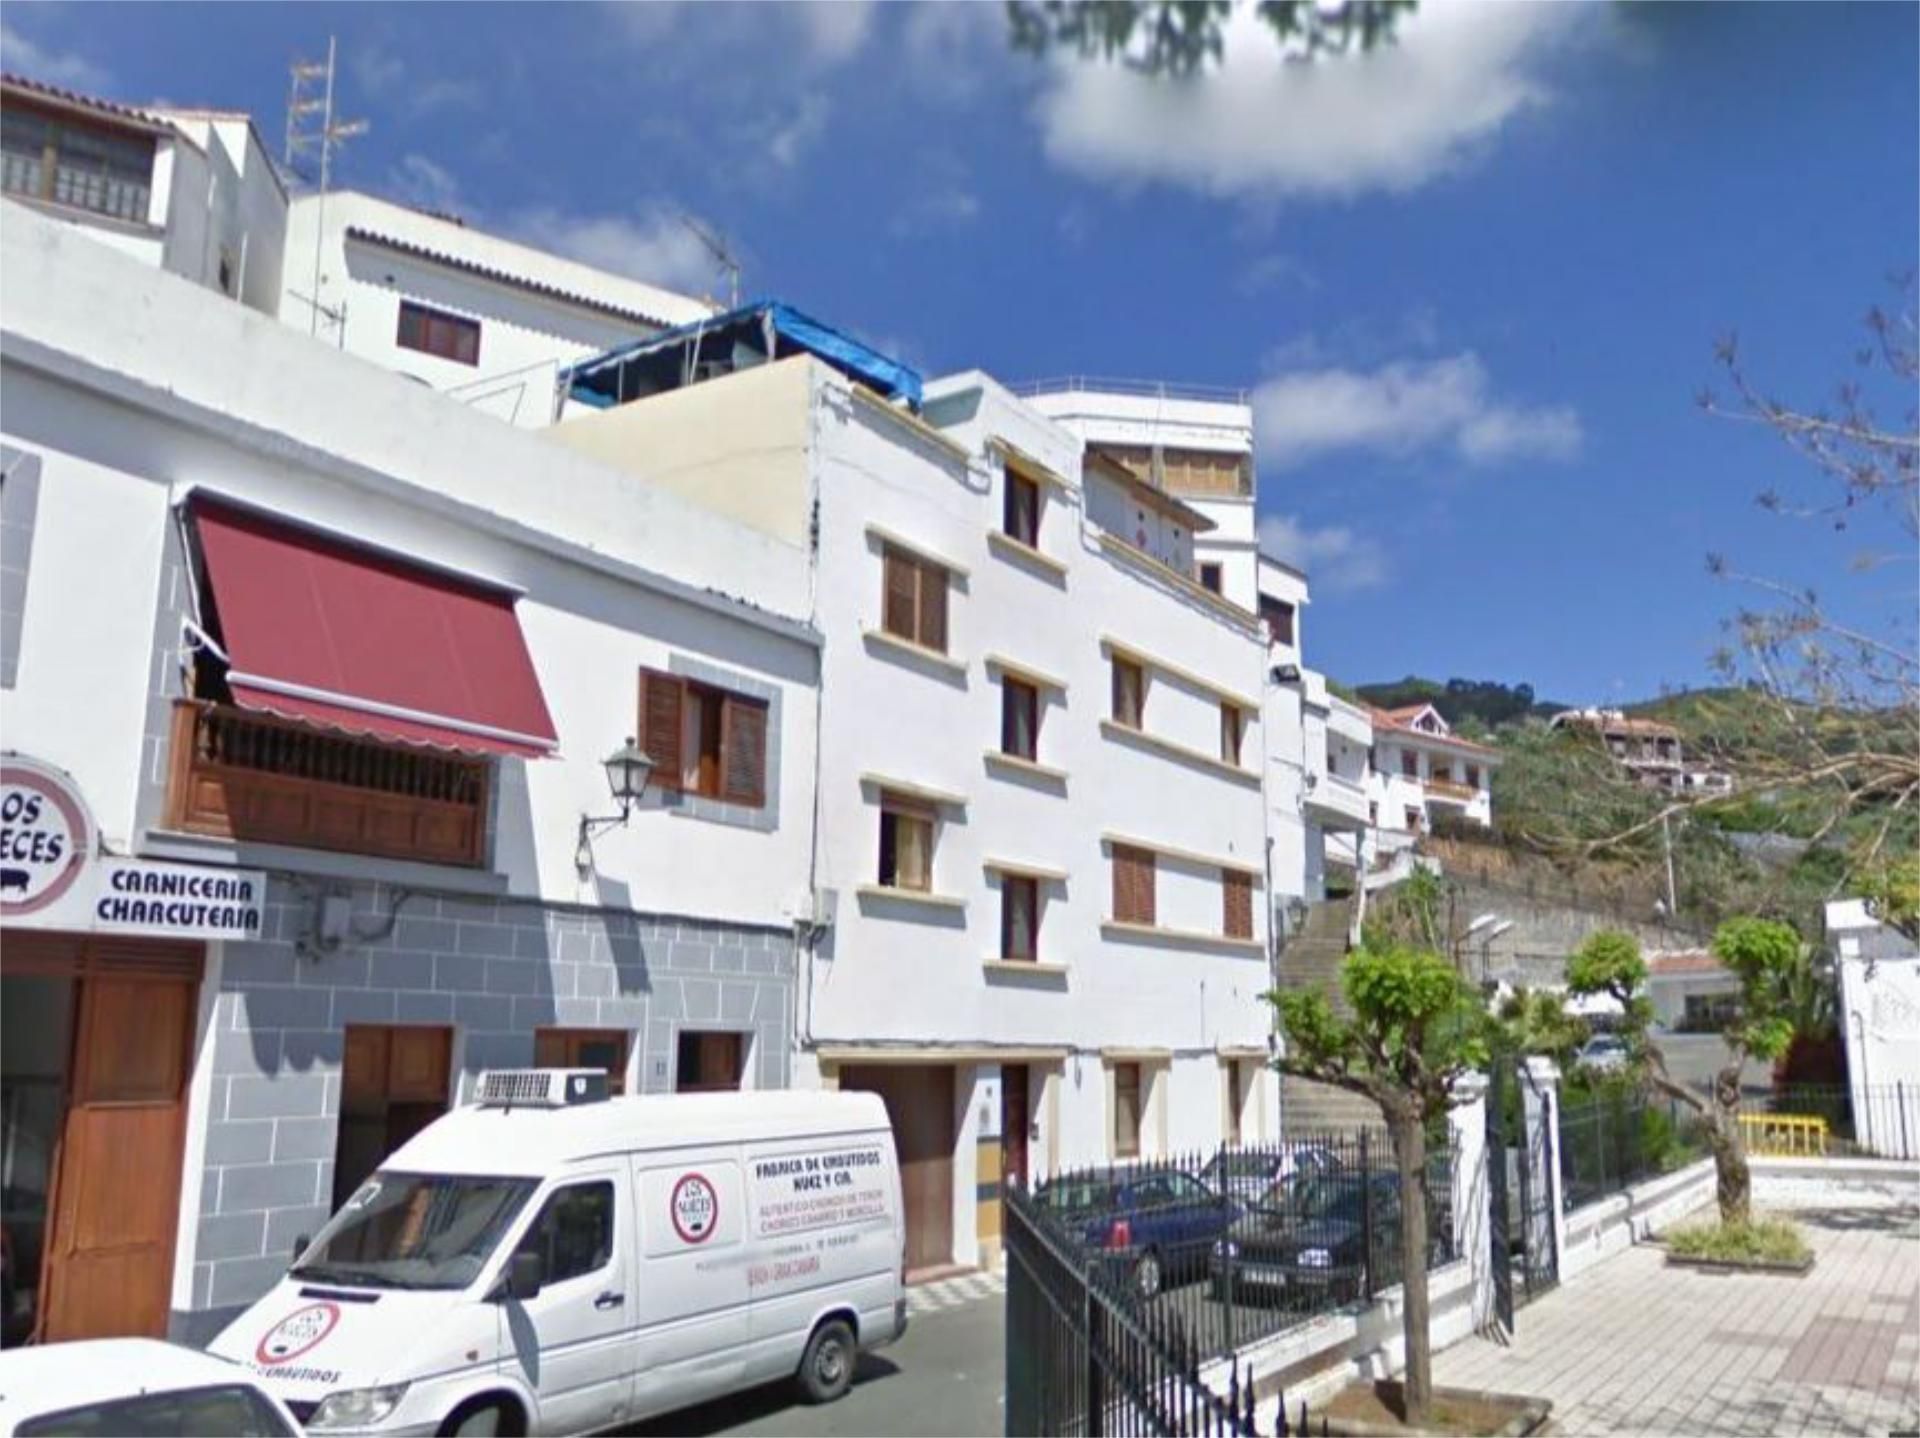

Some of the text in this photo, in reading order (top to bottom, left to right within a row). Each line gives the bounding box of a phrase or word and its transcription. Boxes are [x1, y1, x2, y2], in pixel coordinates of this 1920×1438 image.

[1, 792, 42, 826] OS
[0, 828, 65, 865] ECES
[111, 868, 254, 901] CARNICERIA
[97, 897, 260, 931] CHARCUTERIA
[756, 1151, 881, 1180] FABRICA DE EMBUTIDOS
